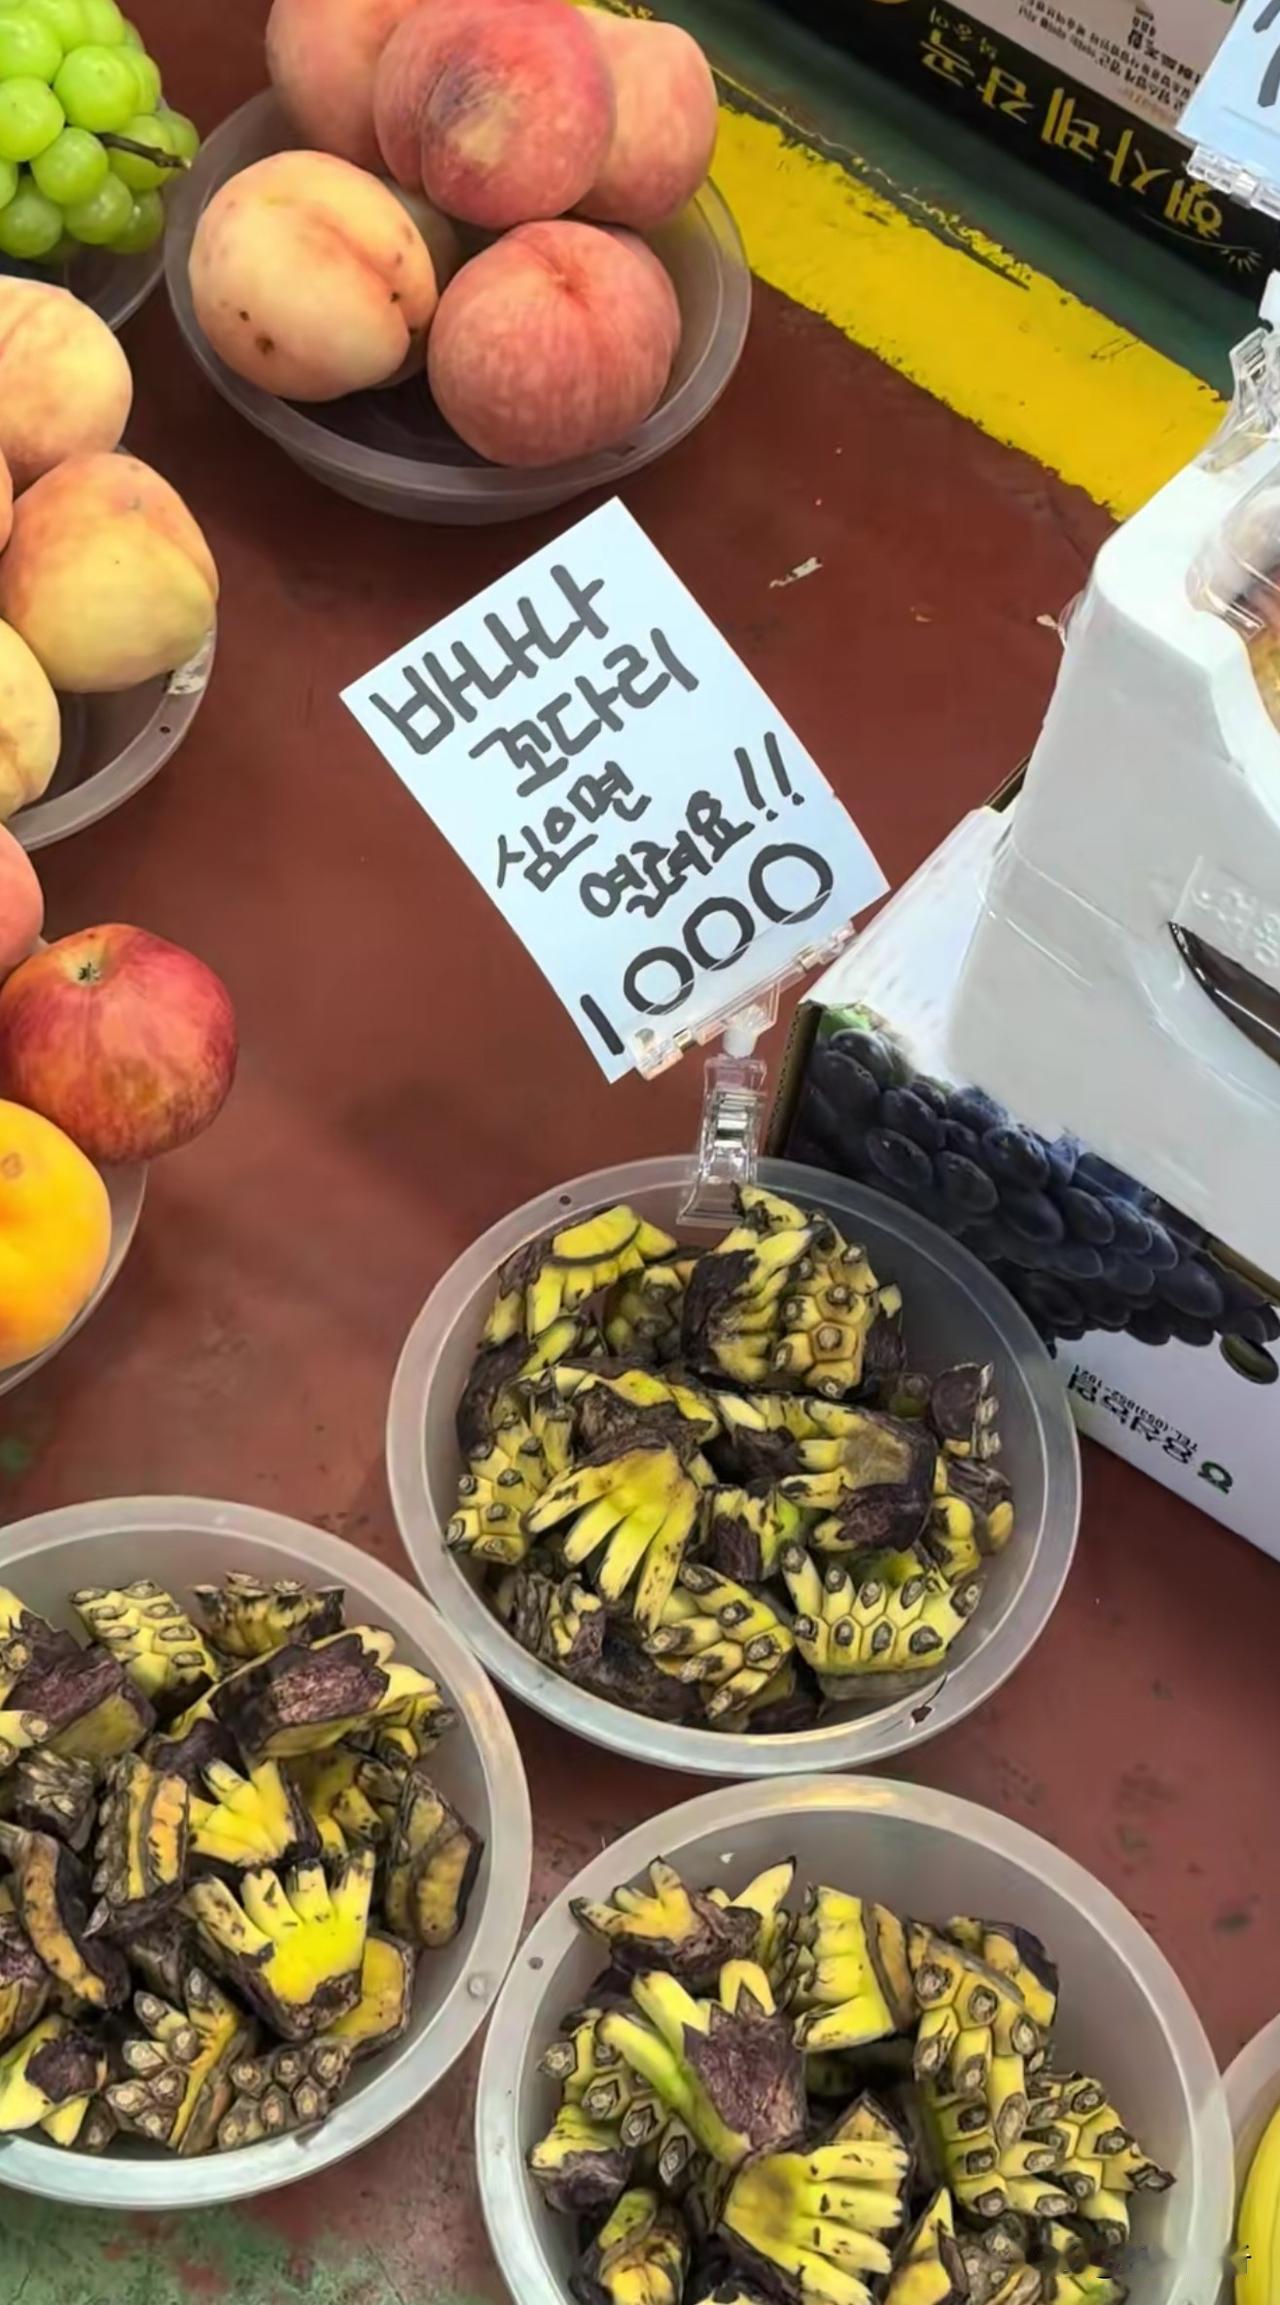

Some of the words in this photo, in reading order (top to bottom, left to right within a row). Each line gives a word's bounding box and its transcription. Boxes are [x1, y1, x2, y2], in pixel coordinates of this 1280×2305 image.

[369, 564, 610, 755] 바나나
[468, 627, 699, 798] 꼬다리
[495, 760, 652, 892] 심으면
[579, 841, 834, 1056] 1000
